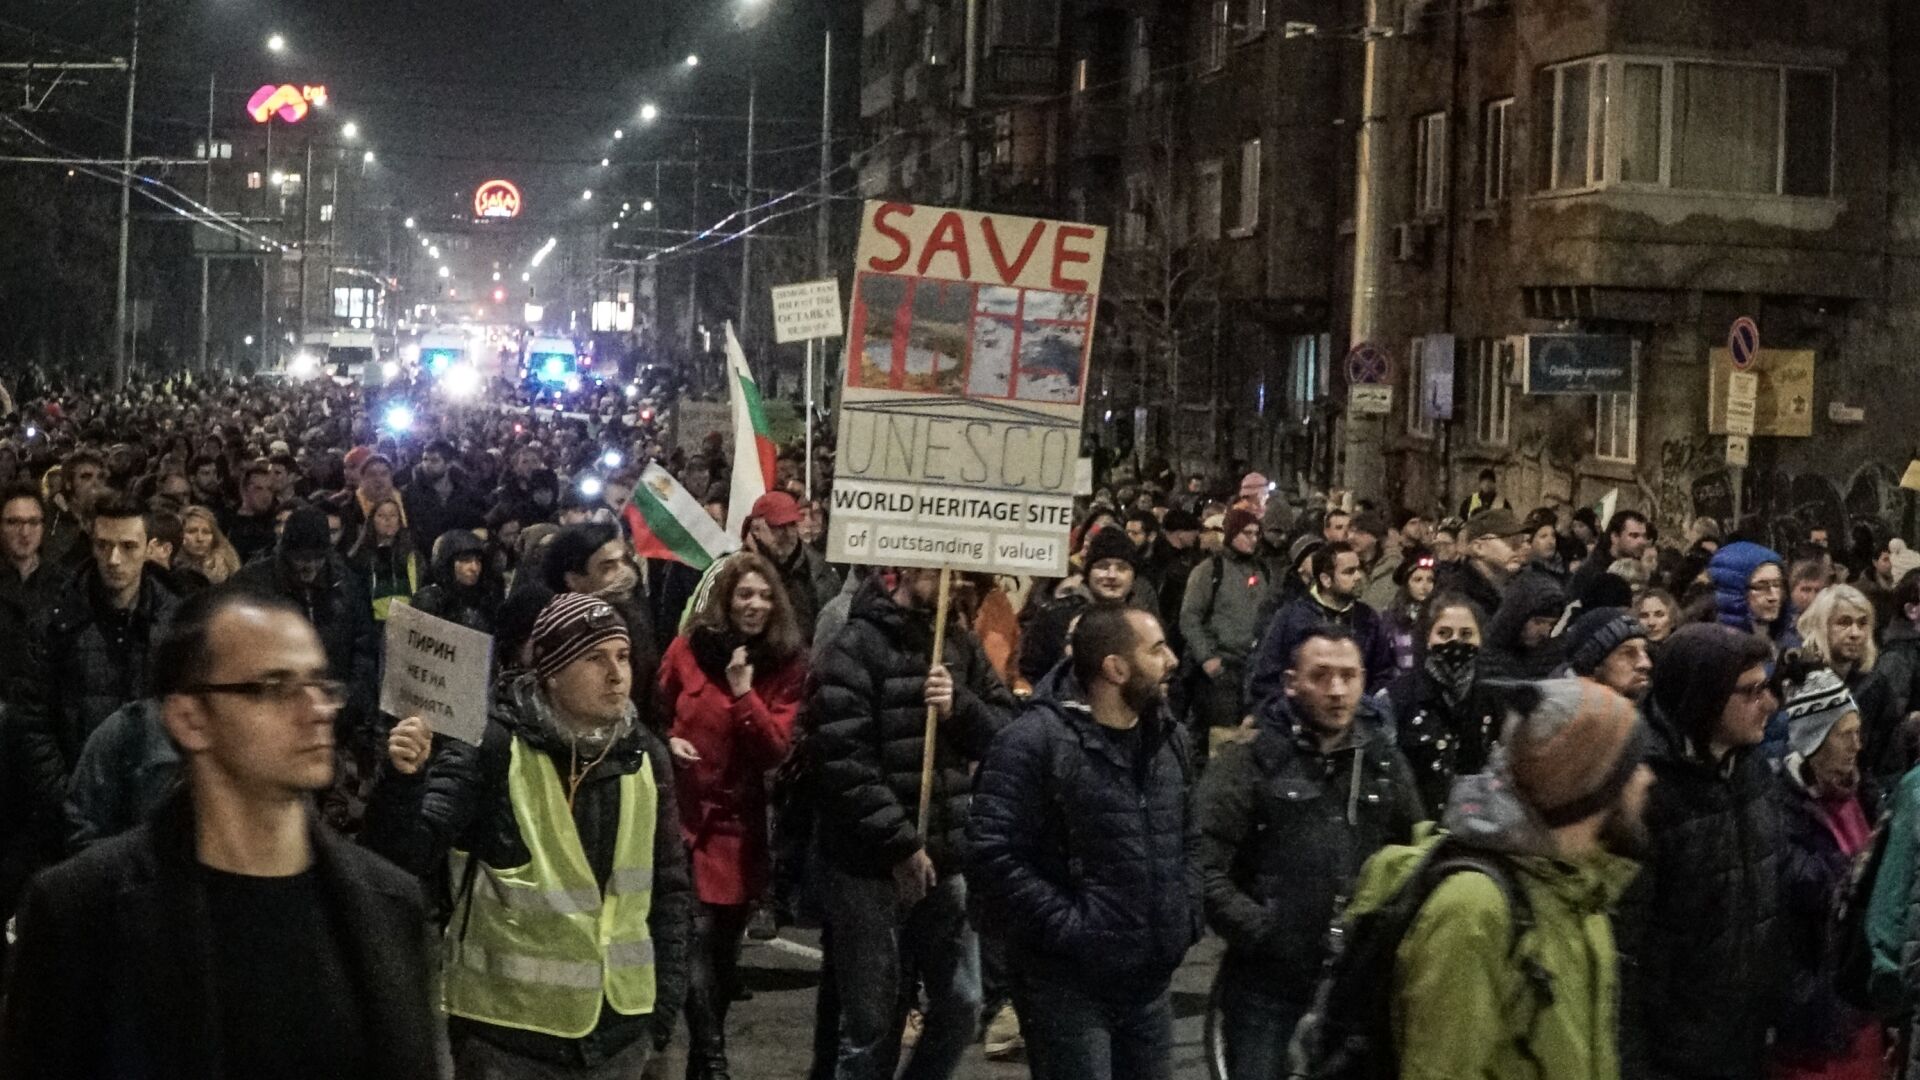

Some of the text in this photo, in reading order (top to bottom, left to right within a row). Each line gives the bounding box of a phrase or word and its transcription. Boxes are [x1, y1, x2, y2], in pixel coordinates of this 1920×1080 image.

[869, 201, 1095, 291] SAVE
[846, 411, 1069, 489] UNESCO
[834, 489, 1072, 525] WORLD HERITAGE SITE
[848, 530, 1054, 561] of outstanding value!
[408, 629, 457, 662] ПИРИН
